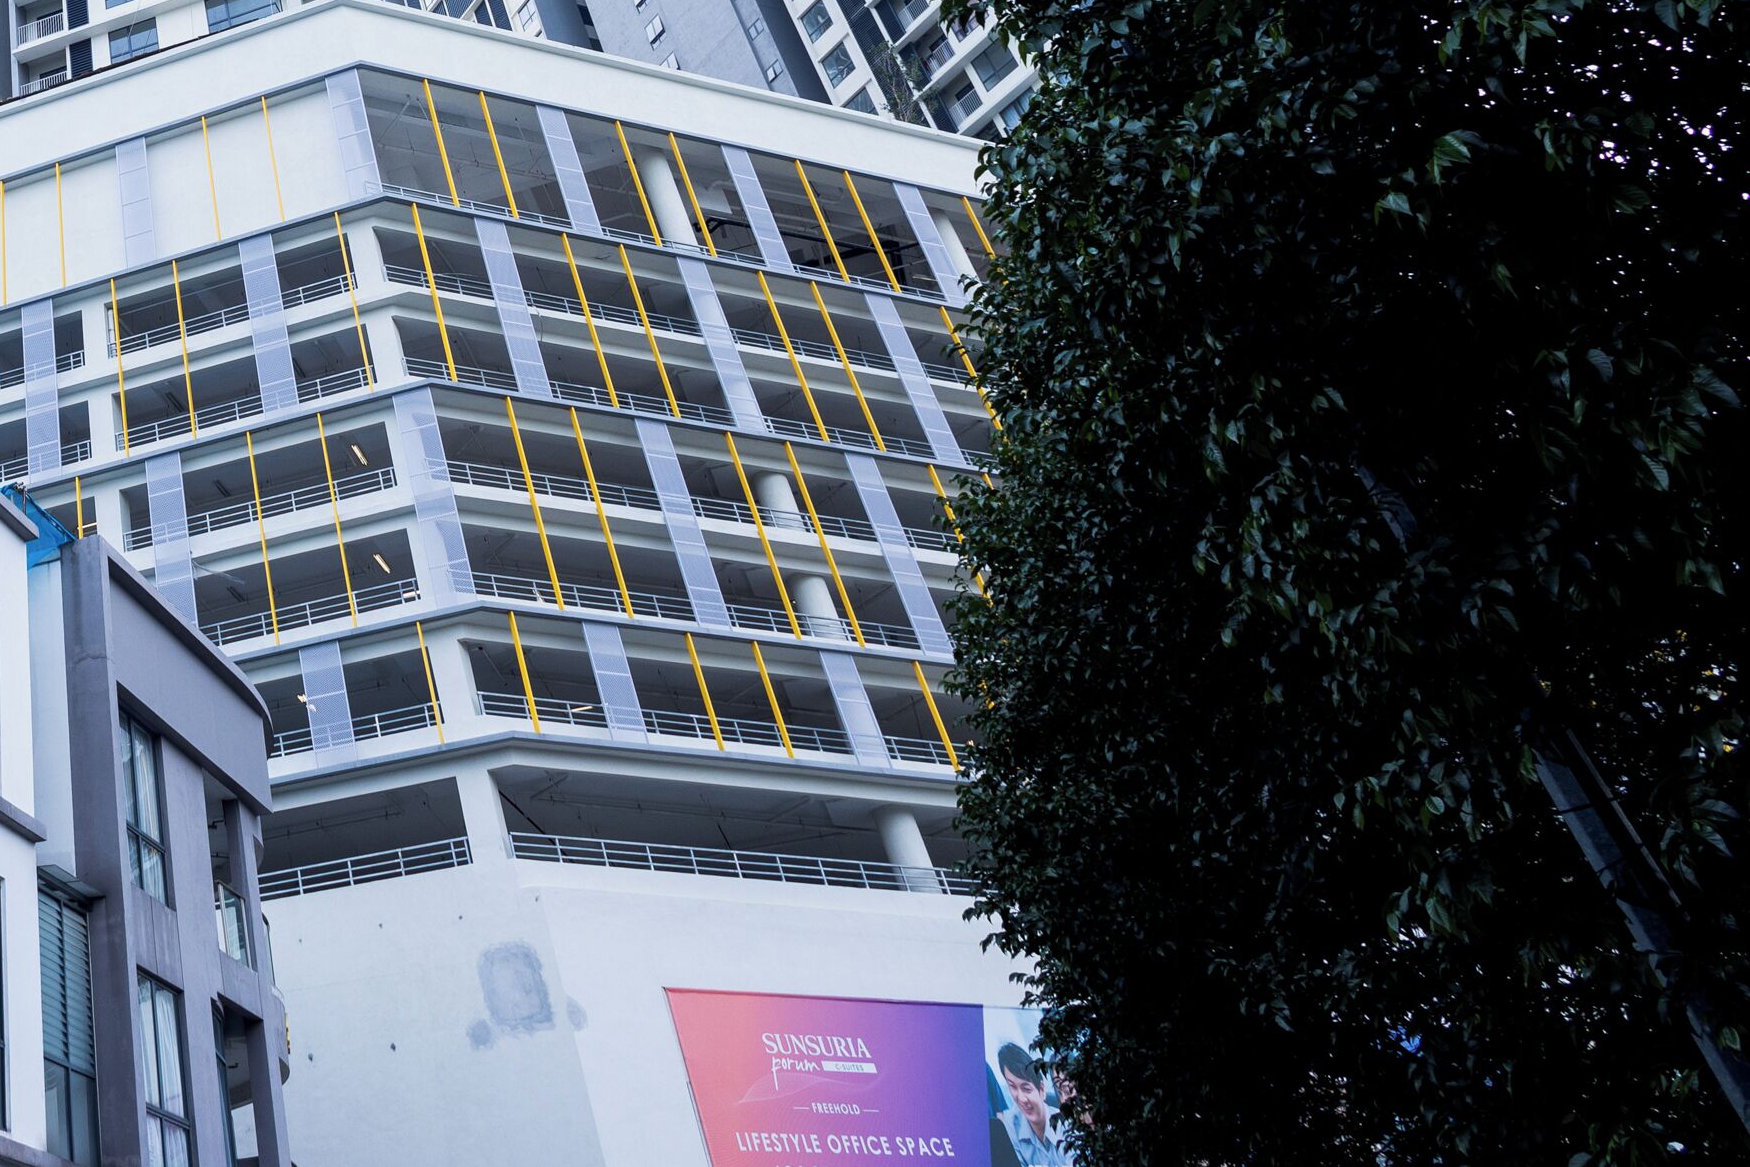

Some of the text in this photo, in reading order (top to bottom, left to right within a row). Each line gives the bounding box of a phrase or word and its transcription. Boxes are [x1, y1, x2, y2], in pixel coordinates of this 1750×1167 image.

[762, 1033, 872, 1058] SUNSURIA
[811, 1102, 861, 1114] FREEHOLD
[736, 1132, 955, 1157] LIFESTYLE OFFICE SPACE
